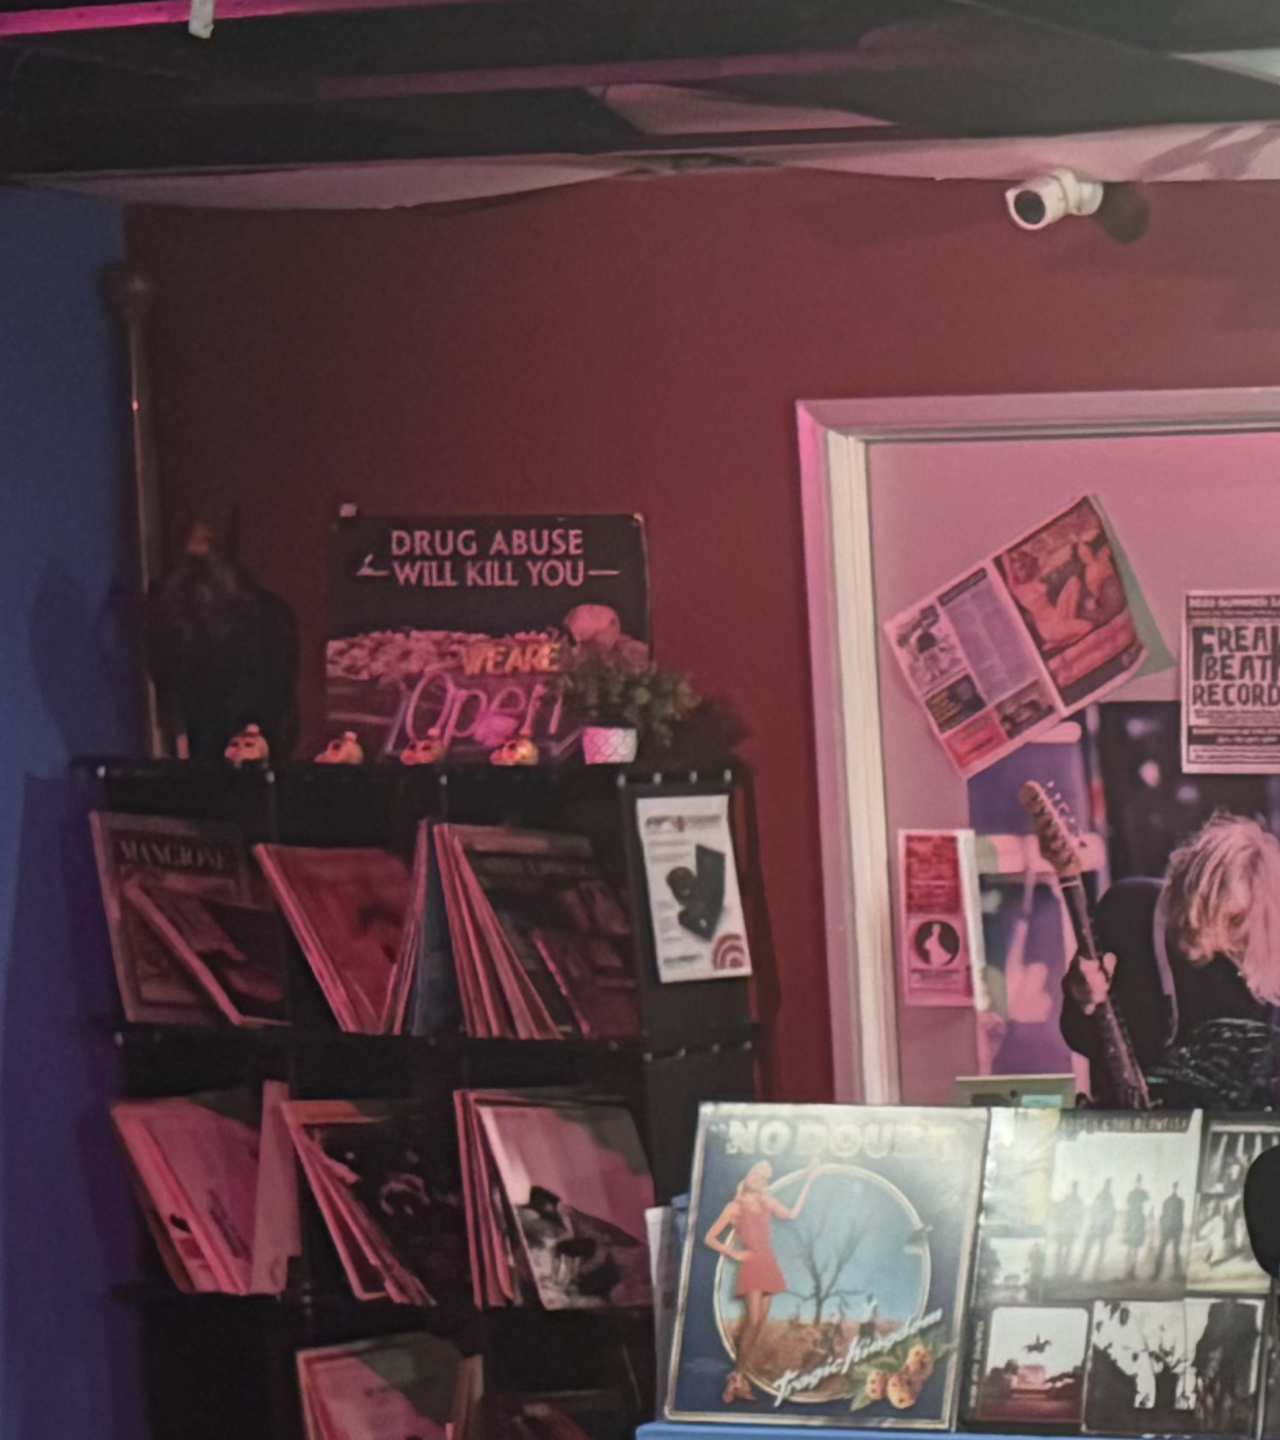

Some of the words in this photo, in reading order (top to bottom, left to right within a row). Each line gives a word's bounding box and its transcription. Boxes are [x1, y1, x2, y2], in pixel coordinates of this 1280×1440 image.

[391, 529, 477, 555] DRUG
[489, 528, 584, 555] ABUSE
[392, 560, 458, 586] WILL
[467, 560, 519, 586] KILL
[526, 560, 584, 586] YOU
[462, 644, 503, 675] WE
[504, 642, 560, 672] ARE
[1205, 655, 1271, 680] BEAT
[726, 1120, 790, 1155] NO
